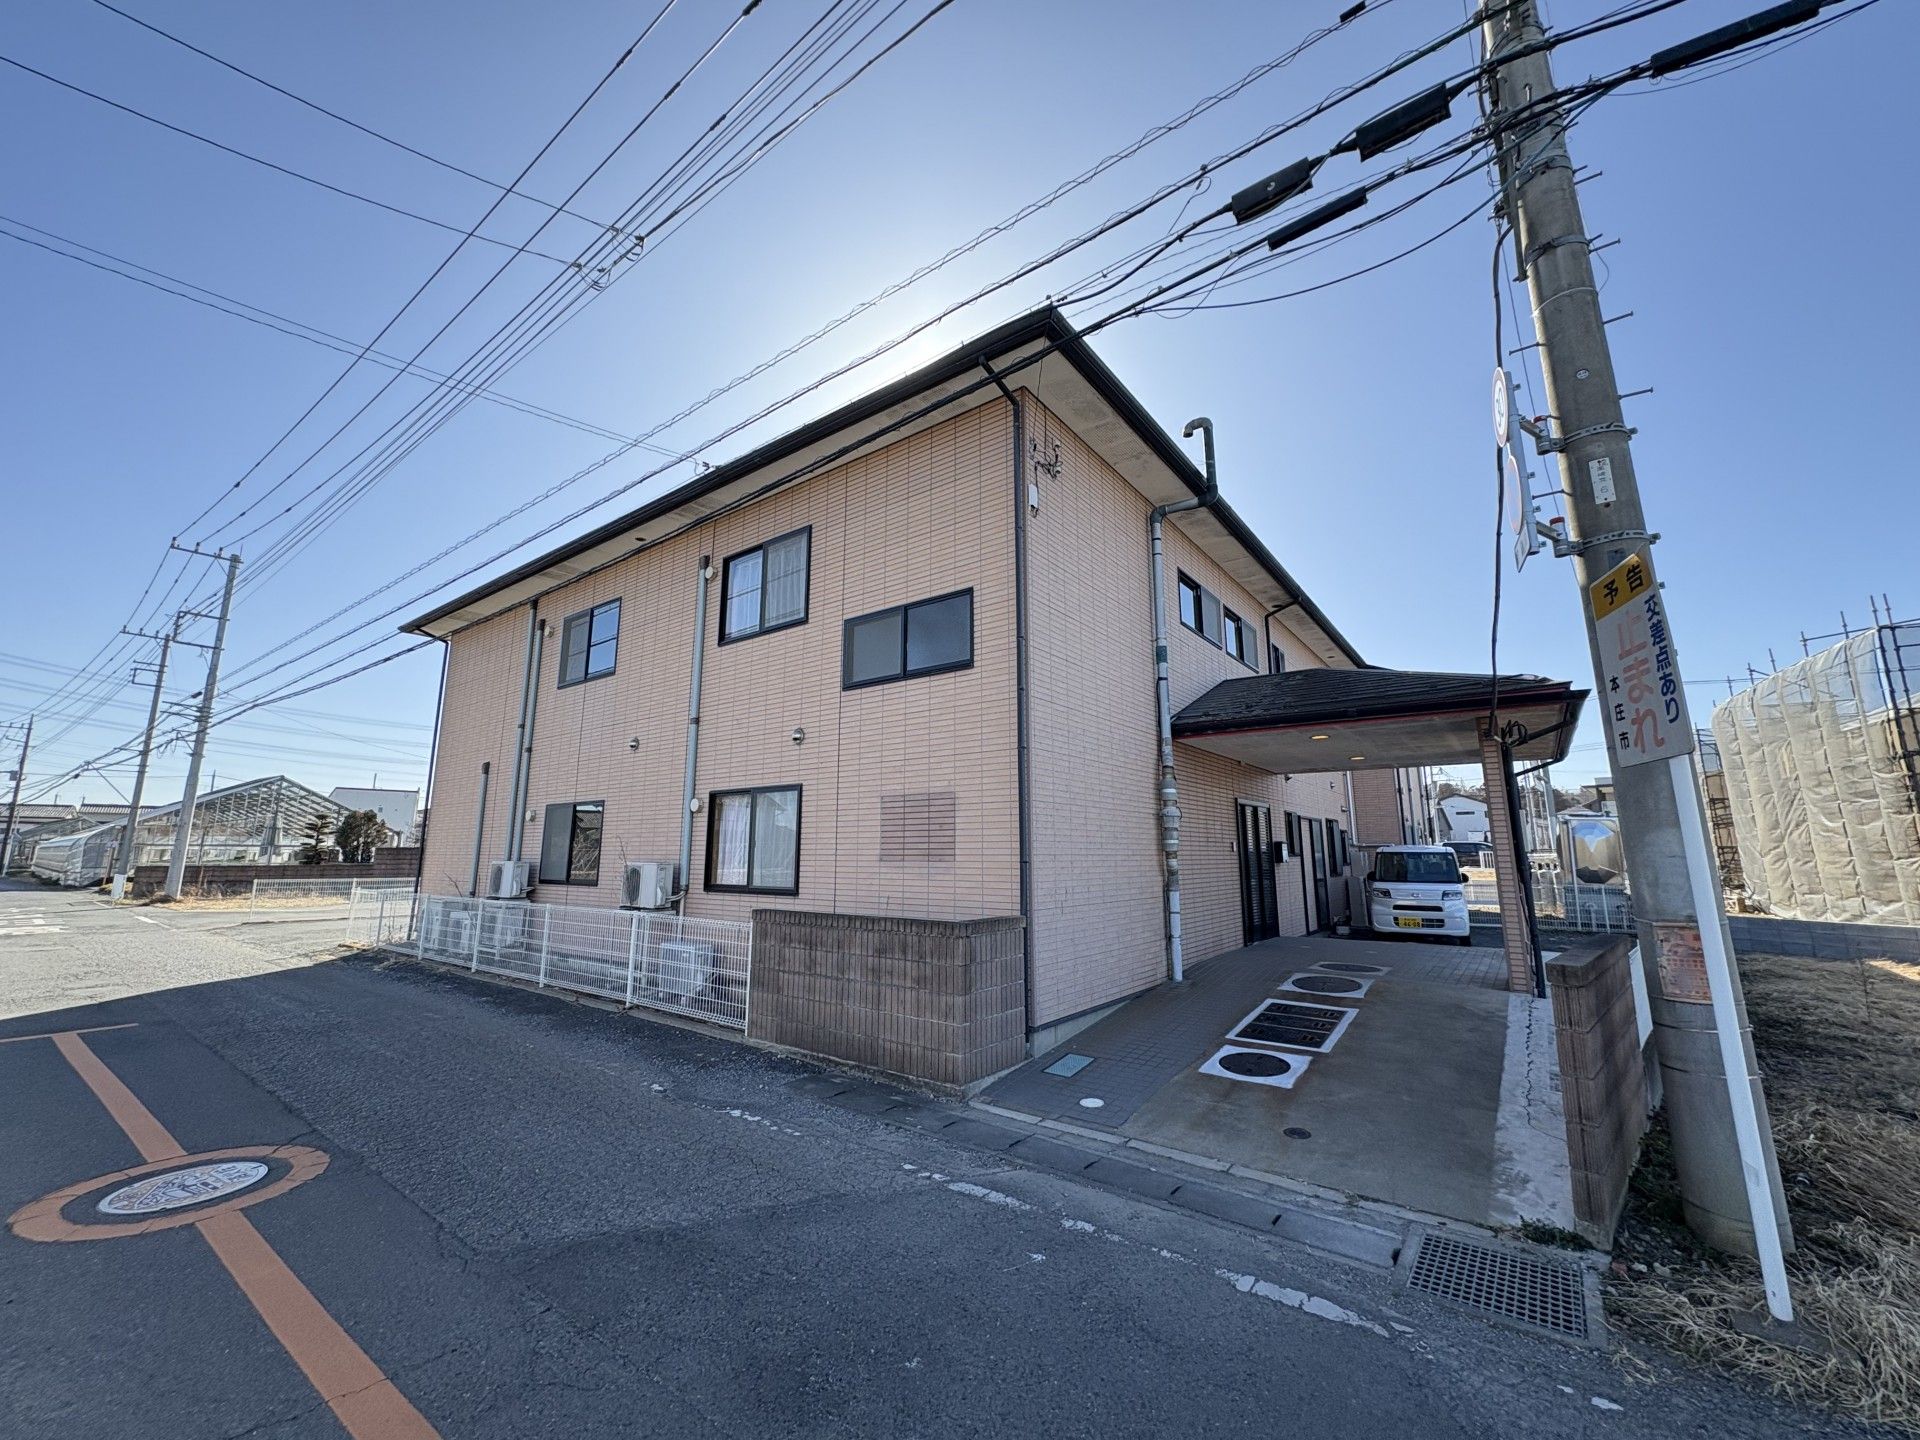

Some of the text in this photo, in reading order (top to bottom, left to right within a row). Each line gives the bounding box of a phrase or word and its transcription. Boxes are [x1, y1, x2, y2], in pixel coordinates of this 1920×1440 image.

[1603, 563, 1643, 606] 予告
[1617, 610, 1665, 754] 止まれ
[1645, 593, 1680, 723] 交差点あり
[1609, 674, 1630, 749] 本庄市
